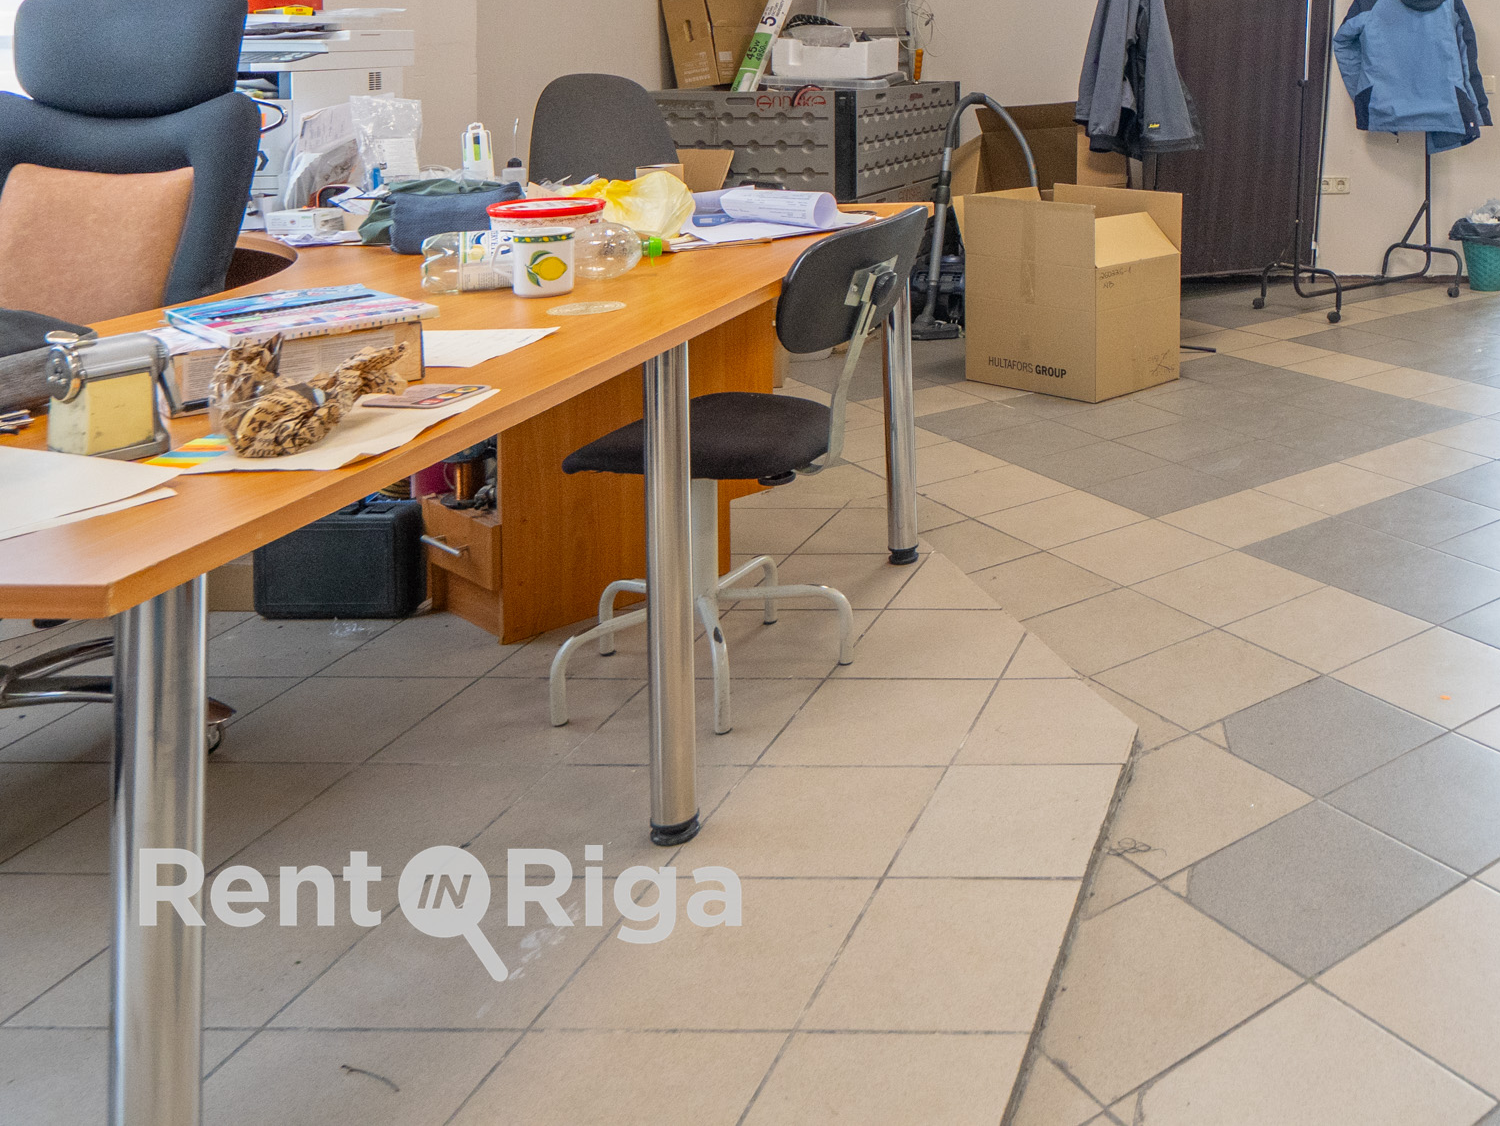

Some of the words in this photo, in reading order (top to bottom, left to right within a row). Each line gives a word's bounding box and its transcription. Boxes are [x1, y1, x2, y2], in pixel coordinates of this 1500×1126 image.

[760, 16, 776, 26] 5
[988, 356, 1034, 373] HULTAFORS
[1035, 364, 1067, 378] GROUP
